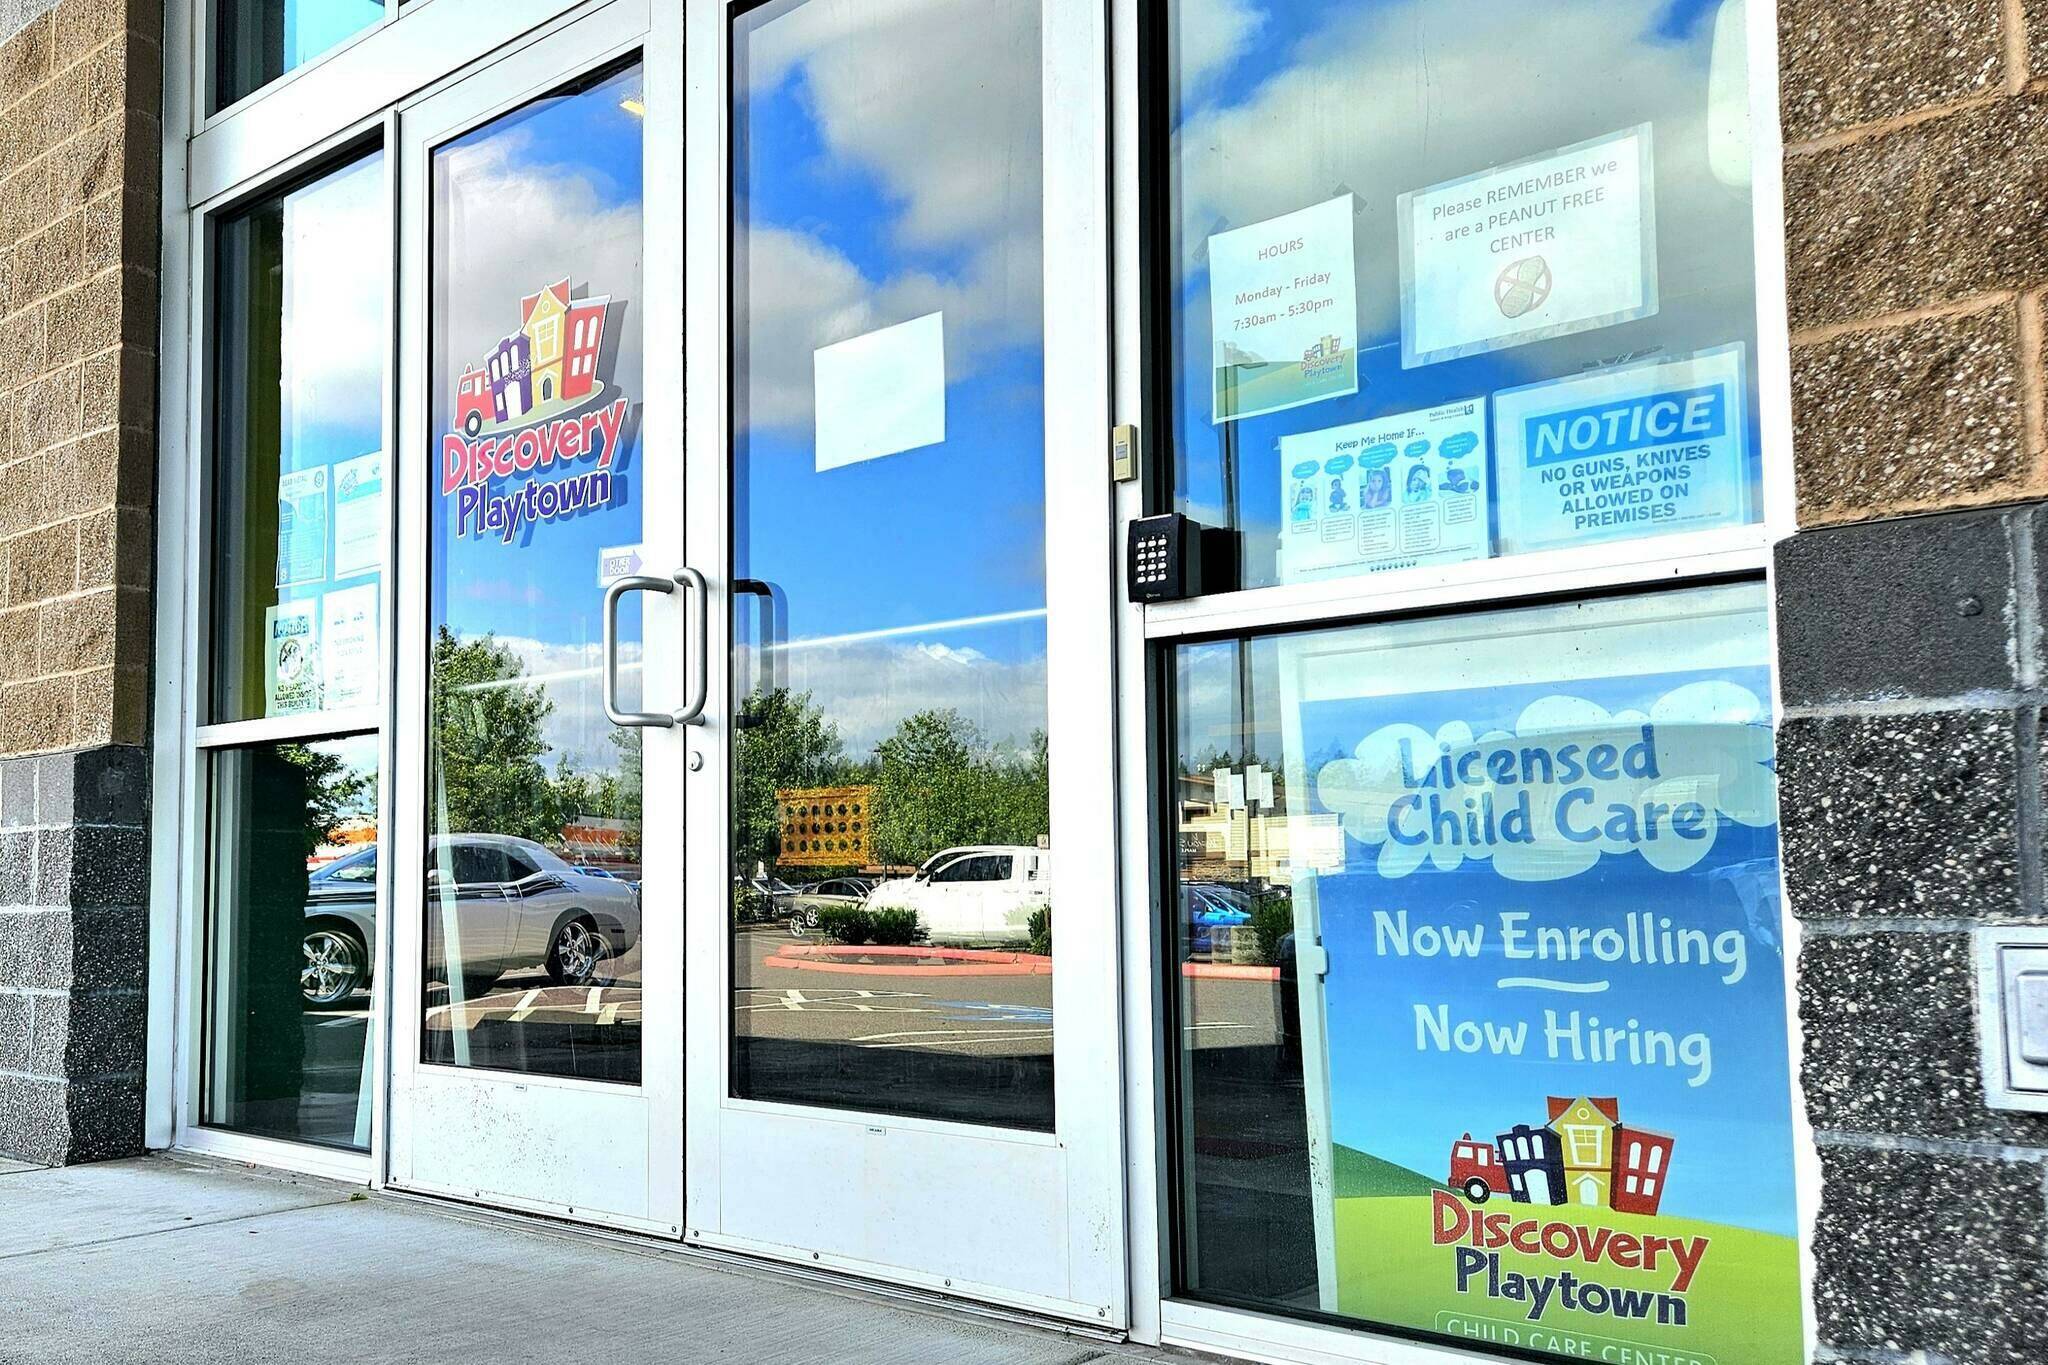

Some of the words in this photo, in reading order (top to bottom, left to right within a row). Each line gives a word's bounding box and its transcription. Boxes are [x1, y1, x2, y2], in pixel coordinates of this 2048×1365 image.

[1432, 198, 1483, 220] Please
[1487, 166, 1587, 204] REMEMBER
[1592, 160, 1618, 176] we
[1445, 225, 1470, 241] are
[1475, 222, 1484, 232] a
[1489, 199, 1558, 229] PEANUT
[1563, 187, 1606, 210] FREE
[1258, 237, 1305, 261] HOURS
[1490, 226, 1556, 253] CENTER
[1235, 284, 1283, 305] Monday
[1294, 271, 1332, 291] Friday
[1234, 314, 1277, 331] 7:30am
[1288, 298, 1334, 317] 5:30pm
[1300, 353, 1346, 371] Discovery
[1304, 364, 1343, 377] Playtown
[443, 398, 628, 495] Discovery
[1335, 439, 1359, 452] Keep
[1361, 434, 1376, 447] Me
[1378, 429, 1405, 443] Home
[1535, 394, 1716, 458] NOTICE
[1541, 467, 1566, 483] NO
[1572, 457, 1630, 476] GUNS,
[1637, 445, 1711, 467] KNIVES
[1559, 480, 1585, 497] OR
[1591, 464, 1691, 492] WEAPONS
[457, 469, 612, 545] Playtown
[1562, 488, 1654, 515] ALLOWED
[1660, 483, 1689, 499] ON
[1574, 502, 1677, 530] PREMISES
[1399, 725, 1661, 788] Licensed
[1387, 791, 1535, 845] Child
[1555, 787, 1708, 843] Care
[1373, 910, 1485, 957] Now
[1500, 911, 1747, 985] Enrolling
[1413, 1004, 1528, 1056] Now
[1545, 1009, 1712, 1087] Hiring
[1431, 1189, 1710, 1293] Discovery
[1455, 1247, 1689, 1327] Playtown
